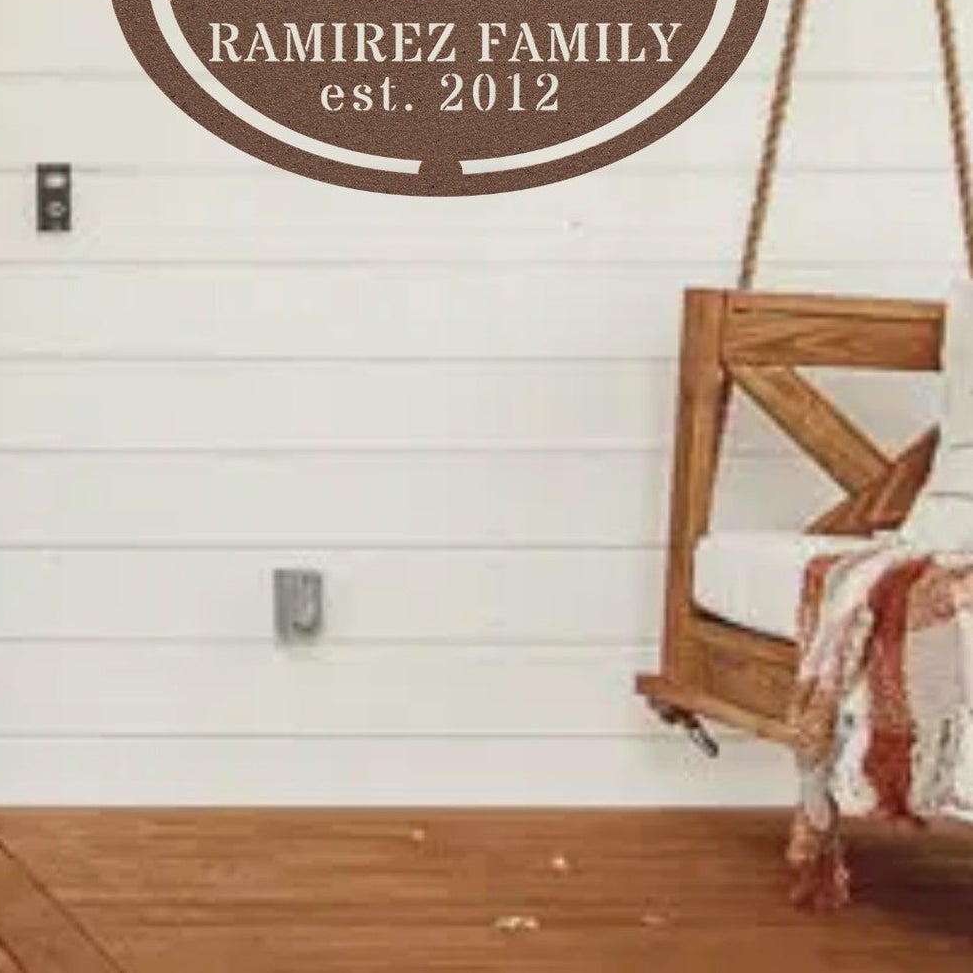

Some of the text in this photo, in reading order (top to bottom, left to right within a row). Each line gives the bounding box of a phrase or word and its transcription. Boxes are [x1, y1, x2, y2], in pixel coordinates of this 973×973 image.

[209, 22, 683, 63] RAMIREZ FAMILY
[320, 73, 560, 112] est. 2012
